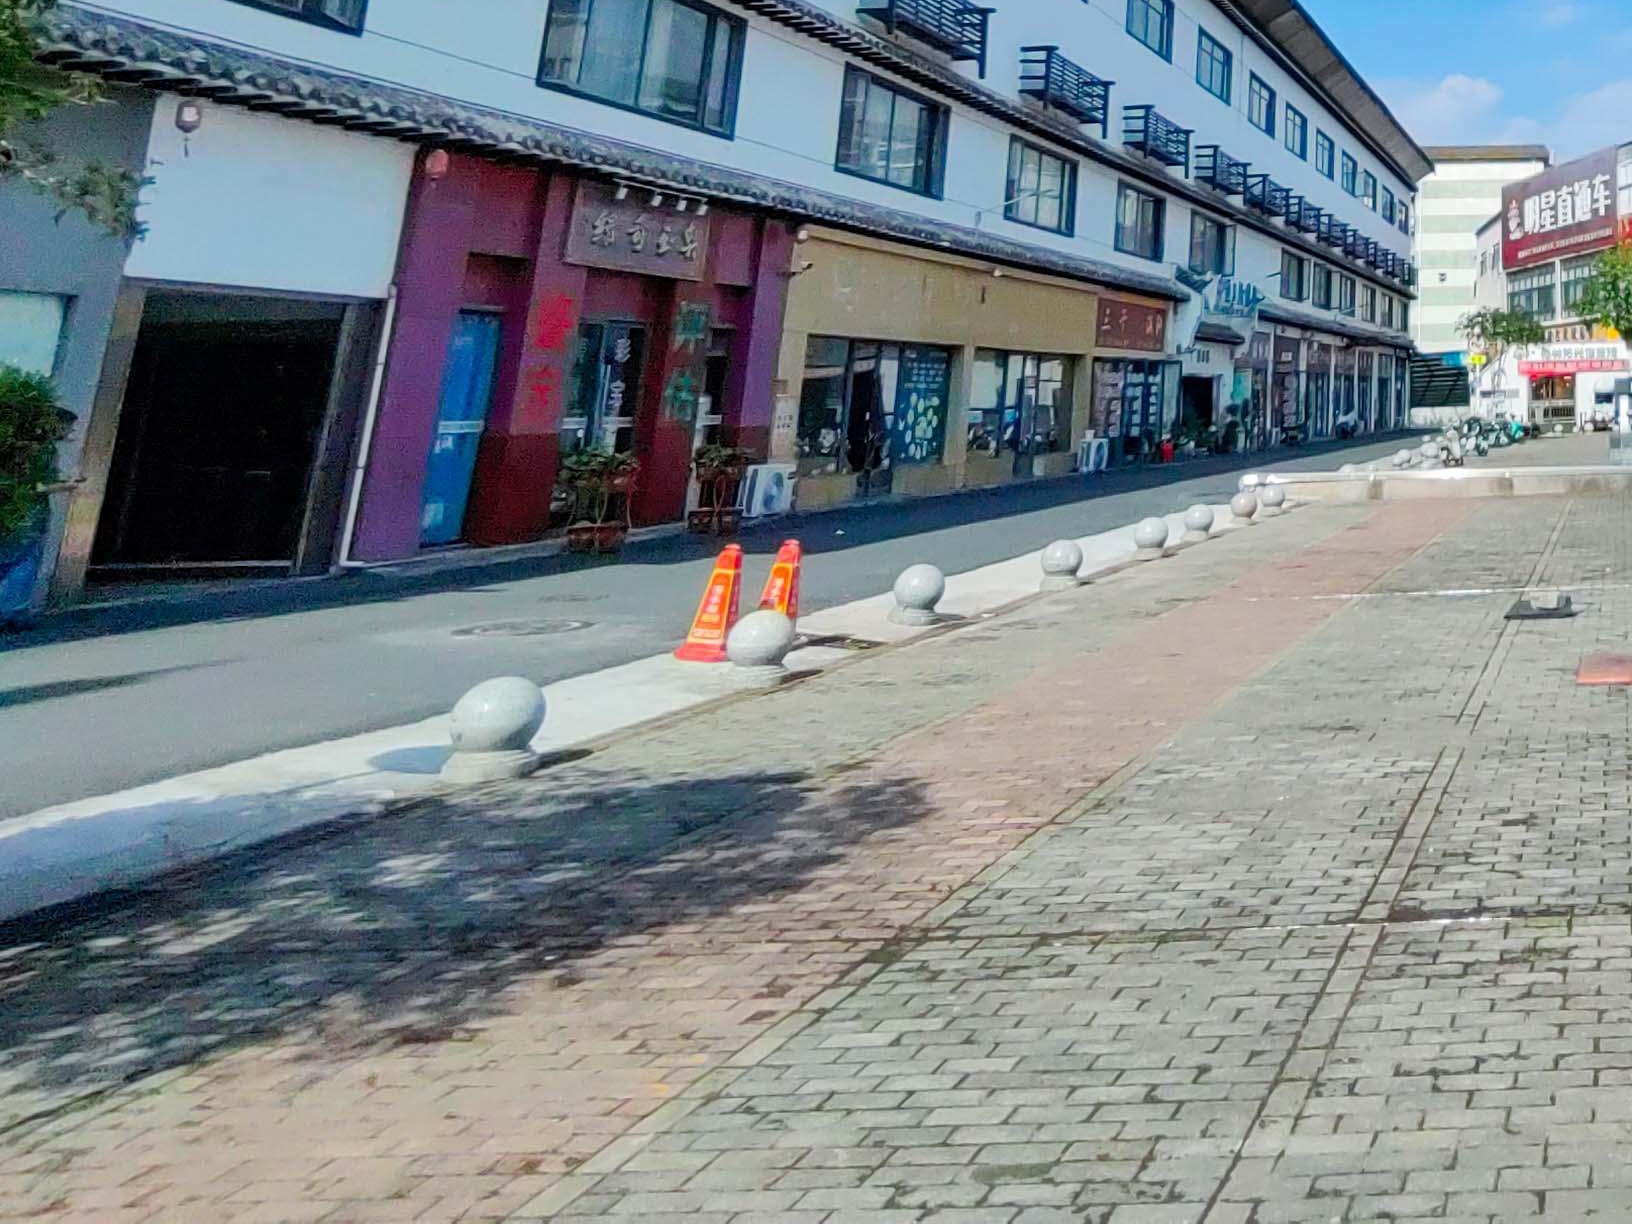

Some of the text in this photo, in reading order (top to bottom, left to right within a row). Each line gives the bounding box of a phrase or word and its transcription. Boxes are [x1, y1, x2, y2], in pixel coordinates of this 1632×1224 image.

[1523, 173, 1612, 235] 明星直通车
